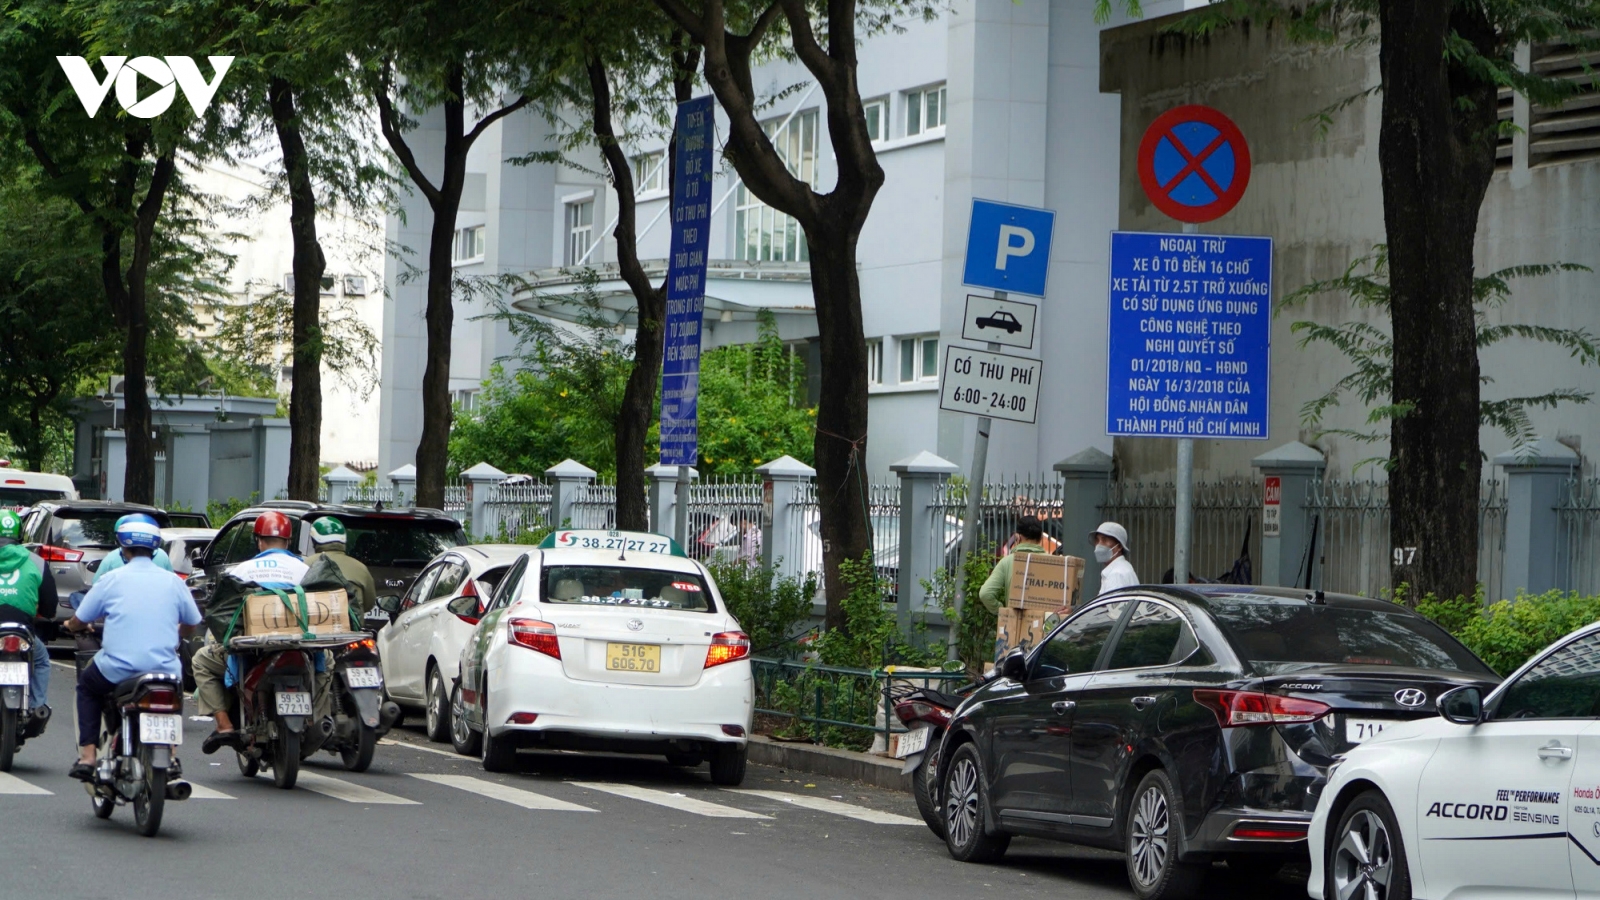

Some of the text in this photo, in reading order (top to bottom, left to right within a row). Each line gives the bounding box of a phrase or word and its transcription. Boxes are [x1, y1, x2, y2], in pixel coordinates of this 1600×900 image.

[694, 158, 702, 173] XE
[676, 198, 707, 223] CÓ THU PHÍ
[683, 228, 698, 244] THEO
[1160, 236, 1227, 254] NGOẠI TRỪ
[995, 224, 1036, 270] P
[1133, 254, 1253, 275] XE Ô TÔ ĐẾN 16 CHỖ
[1113, 278, 1128, 291] XE
[1132, 275, 1150, 292] TẢI
[1154, 276, 1170, 292] TỪ
[1203, 276, 1226, 294] TRỞ
[1228, 277, 1268, 296] XUỐNG
[667, 299, 686, 315] TRONG
[1122, 294, 1258, 317] CÓ SỬ DỤNG ỨNG DỤNG
[1140, 316, 1241, 336] CÔNG NGHỆ THEO
[1146, 337, 1236, 356] NGHỊ QUYẾT SỐ
[954, 356, 1034, 386] CÓ THU PHÍ
[1131, 358, 1201, 374] 01/2018/NQ
[1216, 361, 1248, 374] HĐND
[1129, 376, 1250, 394] NGÀY 16/3/2018 CỦA
[1130, 394, 1248, 414] HỘI ĐỒNG NHÂN DÂN
[1117, 416, 1260, 435] THÀNH PHỐ HỒ CHÍ MINH
[1266, 480, 1280, 502] CẤM
[628, 540, 645, 551] 27
[649, 542, 668, 553] 27
[1394, 547, 1416, 565] 97
[622, 645, 646, 658] 51G
[612, 657, 654, 670] 606.70
[281, 694, 304, 703] 59-S1
[901, 741, 921, 755] 7717
[1496, 789, 1510, 801] FEEL
[1515, 790, 1560, 804] PERFORMANCE
[1574, 787, 1593, 799] Honda
[1426, 802, 1508, 821] ACCORD
[1513, 812, 1559, 824] SENSING
